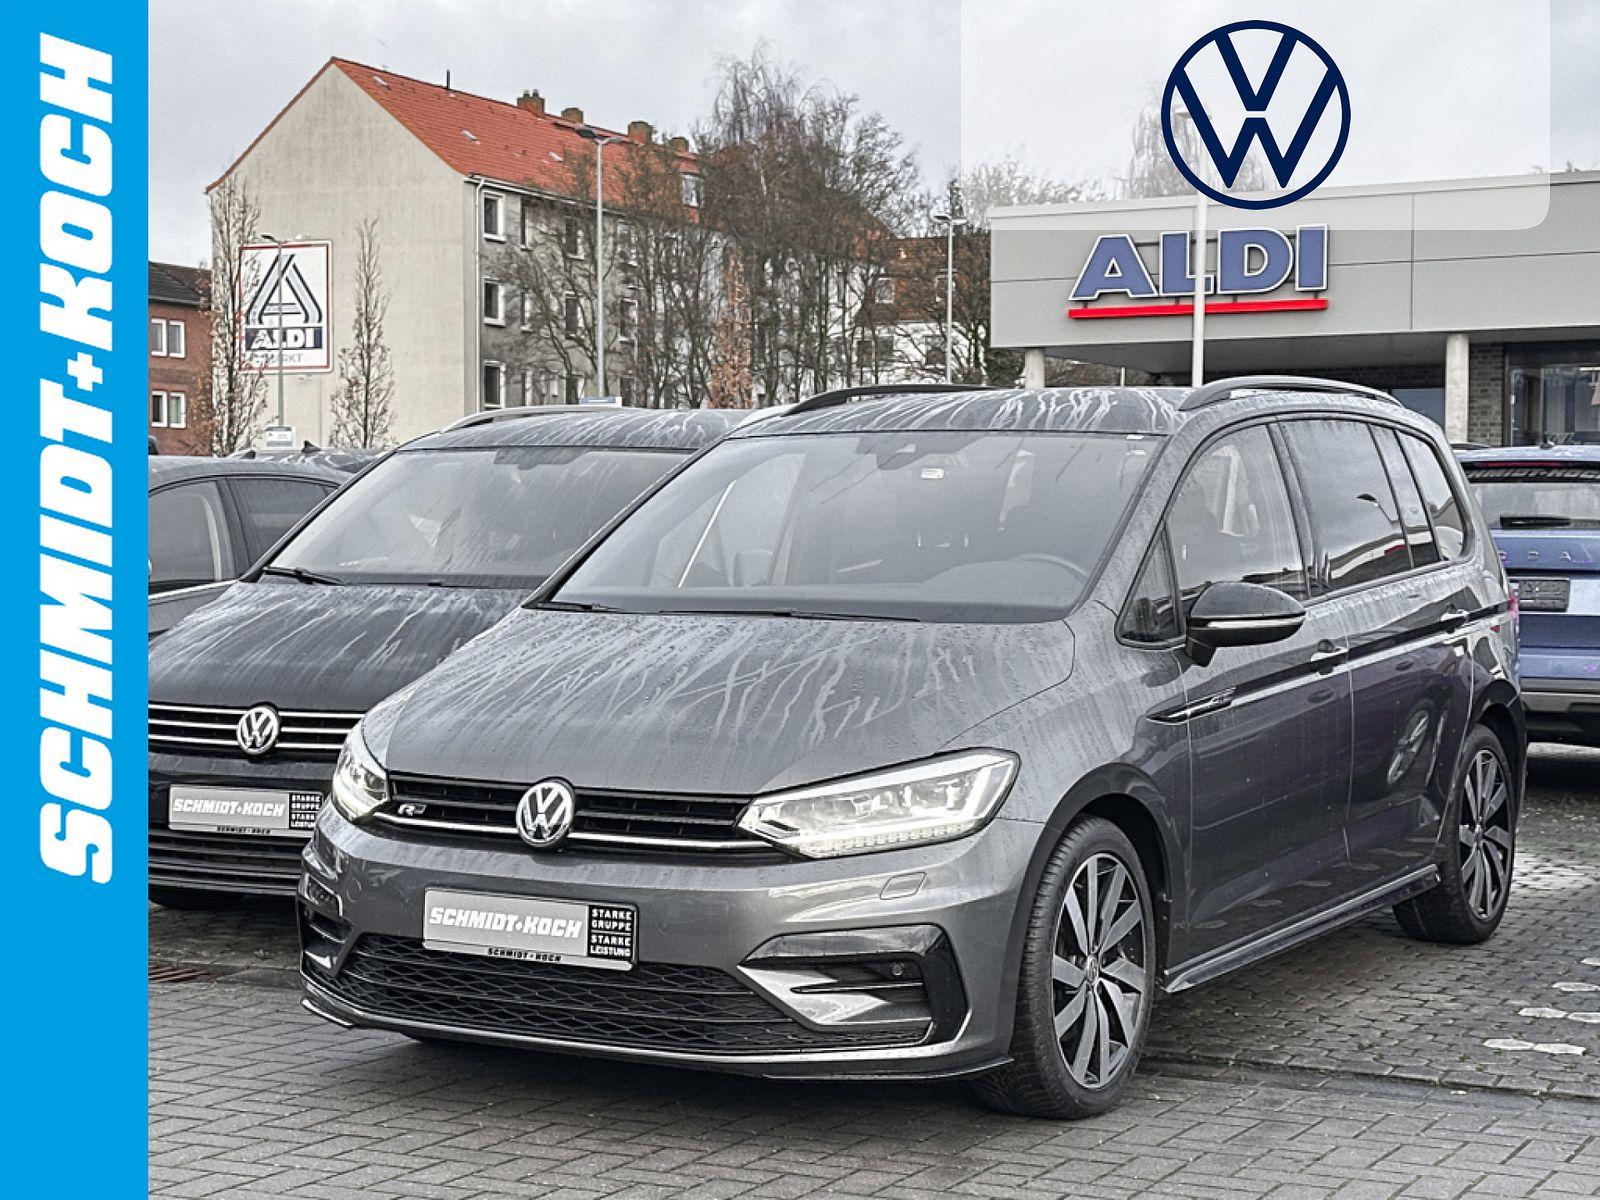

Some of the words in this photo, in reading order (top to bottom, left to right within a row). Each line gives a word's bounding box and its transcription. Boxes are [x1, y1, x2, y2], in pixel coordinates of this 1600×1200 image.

[1069, 224, 1330, 301] ALDI
[250, 328, 315, 348] ALDI
[172, 797, 285, 817] SCHMIDT+KOCH
[591, 908, 632, 920] STARKE
[429, 907, 582, 938] SCHMIDT+KOCH
[591, 919, 632, 931] GRUPPE
[591, 934, 631, 947] STARKE
[590, 945, 631, 957] LEISTUNG
